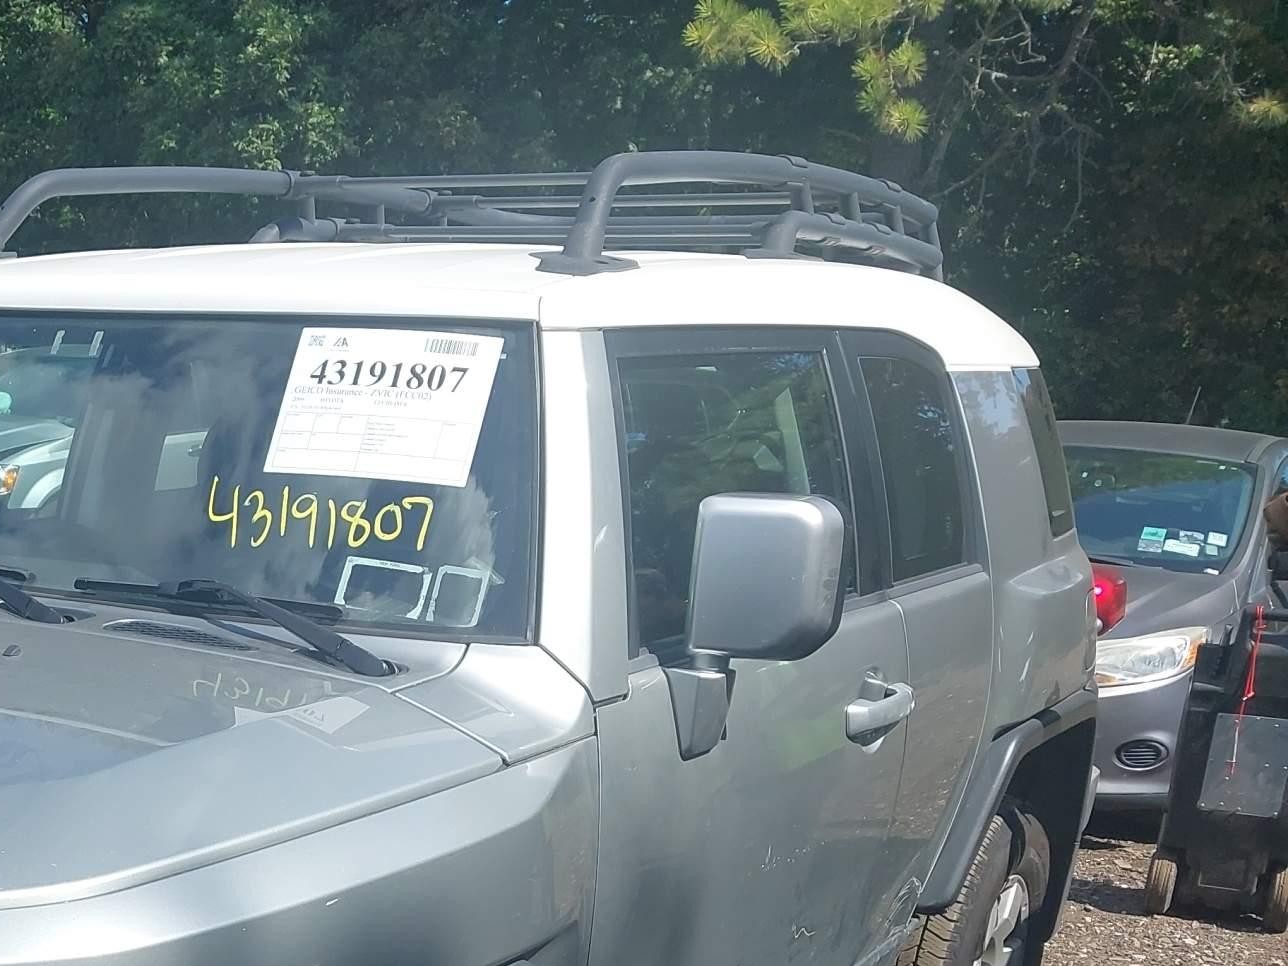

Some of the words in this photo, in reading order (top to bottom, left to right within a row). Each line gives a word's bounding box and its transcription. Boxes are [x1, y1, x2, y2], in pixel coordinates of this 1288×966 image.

[309, 359, 469, 393] 43191807
[325, 386, 363, 397] Insurance
[208, 475, 434, 551] 43191807
